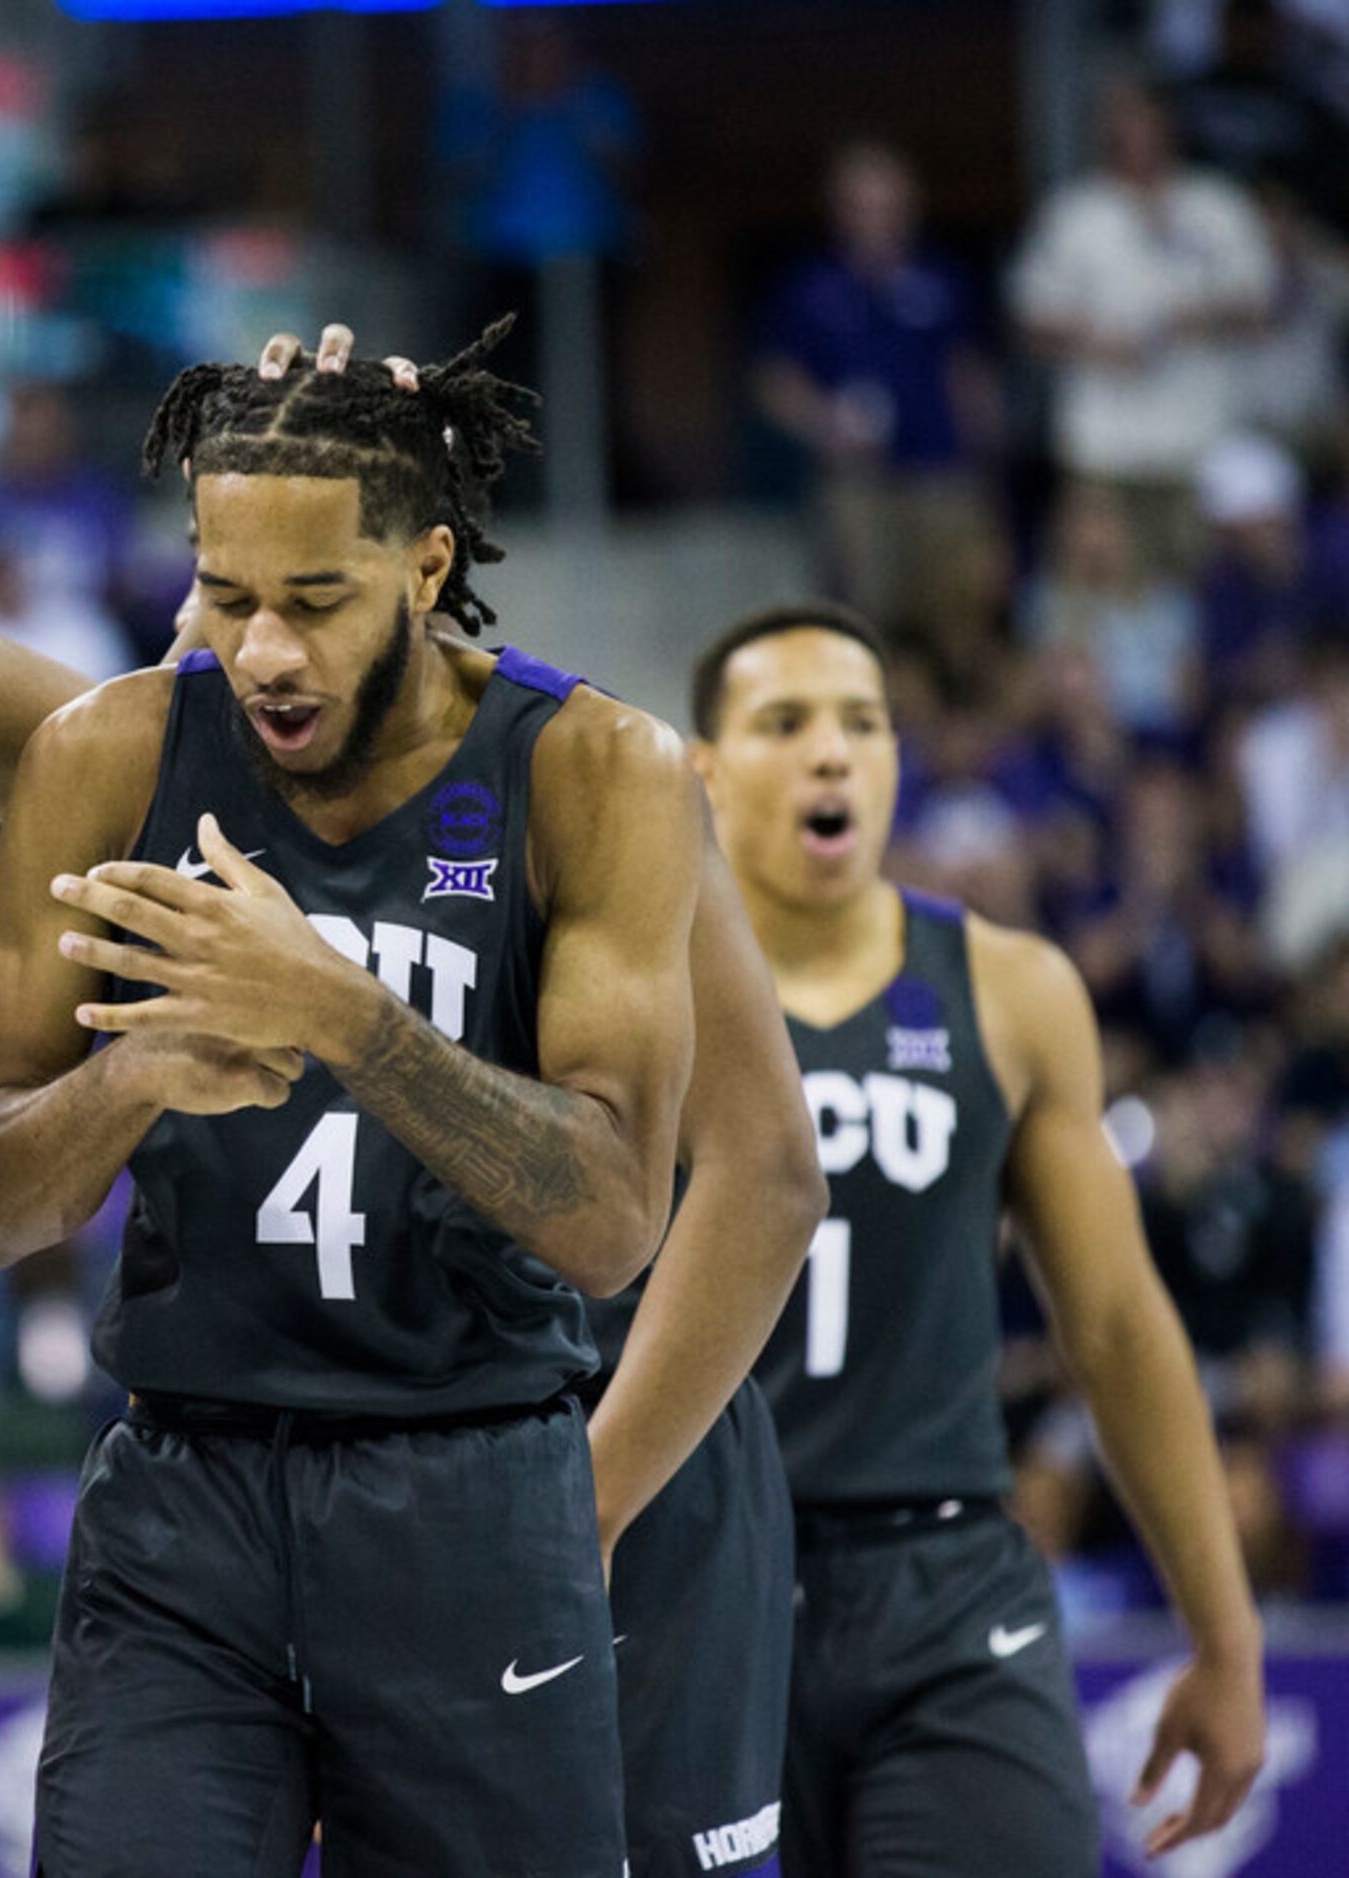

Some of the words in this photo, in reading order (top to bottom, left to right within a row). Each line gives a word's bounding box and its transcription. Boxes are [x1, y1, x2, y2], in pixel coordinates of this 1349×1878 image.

[425, 858, 497, 899] XII
[802, 1070, 956, 1192] CU
[256, 1111, 365, 1299] 4
[806, 1217, 851, 1377] 1
